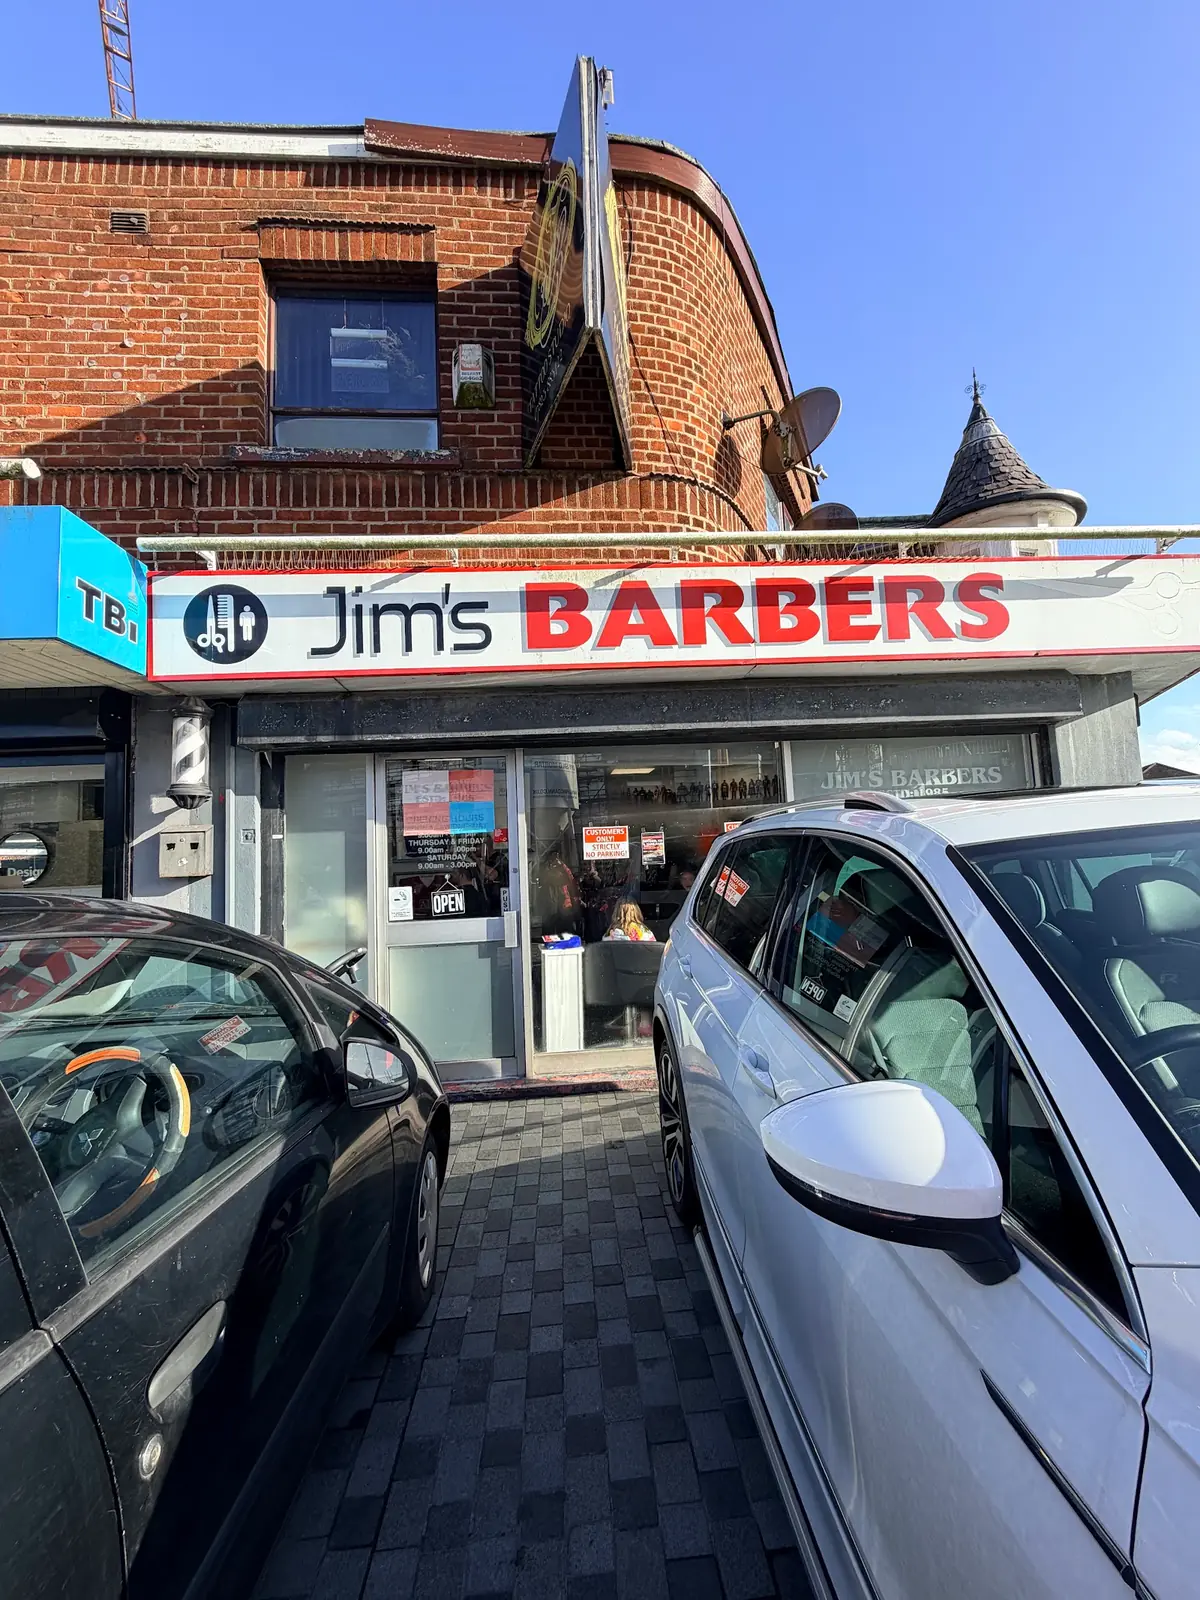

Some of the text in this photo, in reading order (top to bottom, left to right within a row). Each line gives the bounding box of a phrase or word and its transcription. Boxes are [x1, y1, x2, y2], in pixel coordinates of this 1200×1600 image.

[308, 572, 1010, 658] Jim's BARBERS
[821, 766, 1003, 790] JIM'S BARBERS
[586, 828, 624, 836] CUSTOMERS
[408, 838, 449, 847] THURSDAY
[417, 846, 444, 854] 9.00am
[417, 862, 444, 870] 9.00am
[450, 861, 477, 869] 3.00pm
[433, 893, 463, 913] OPEN
